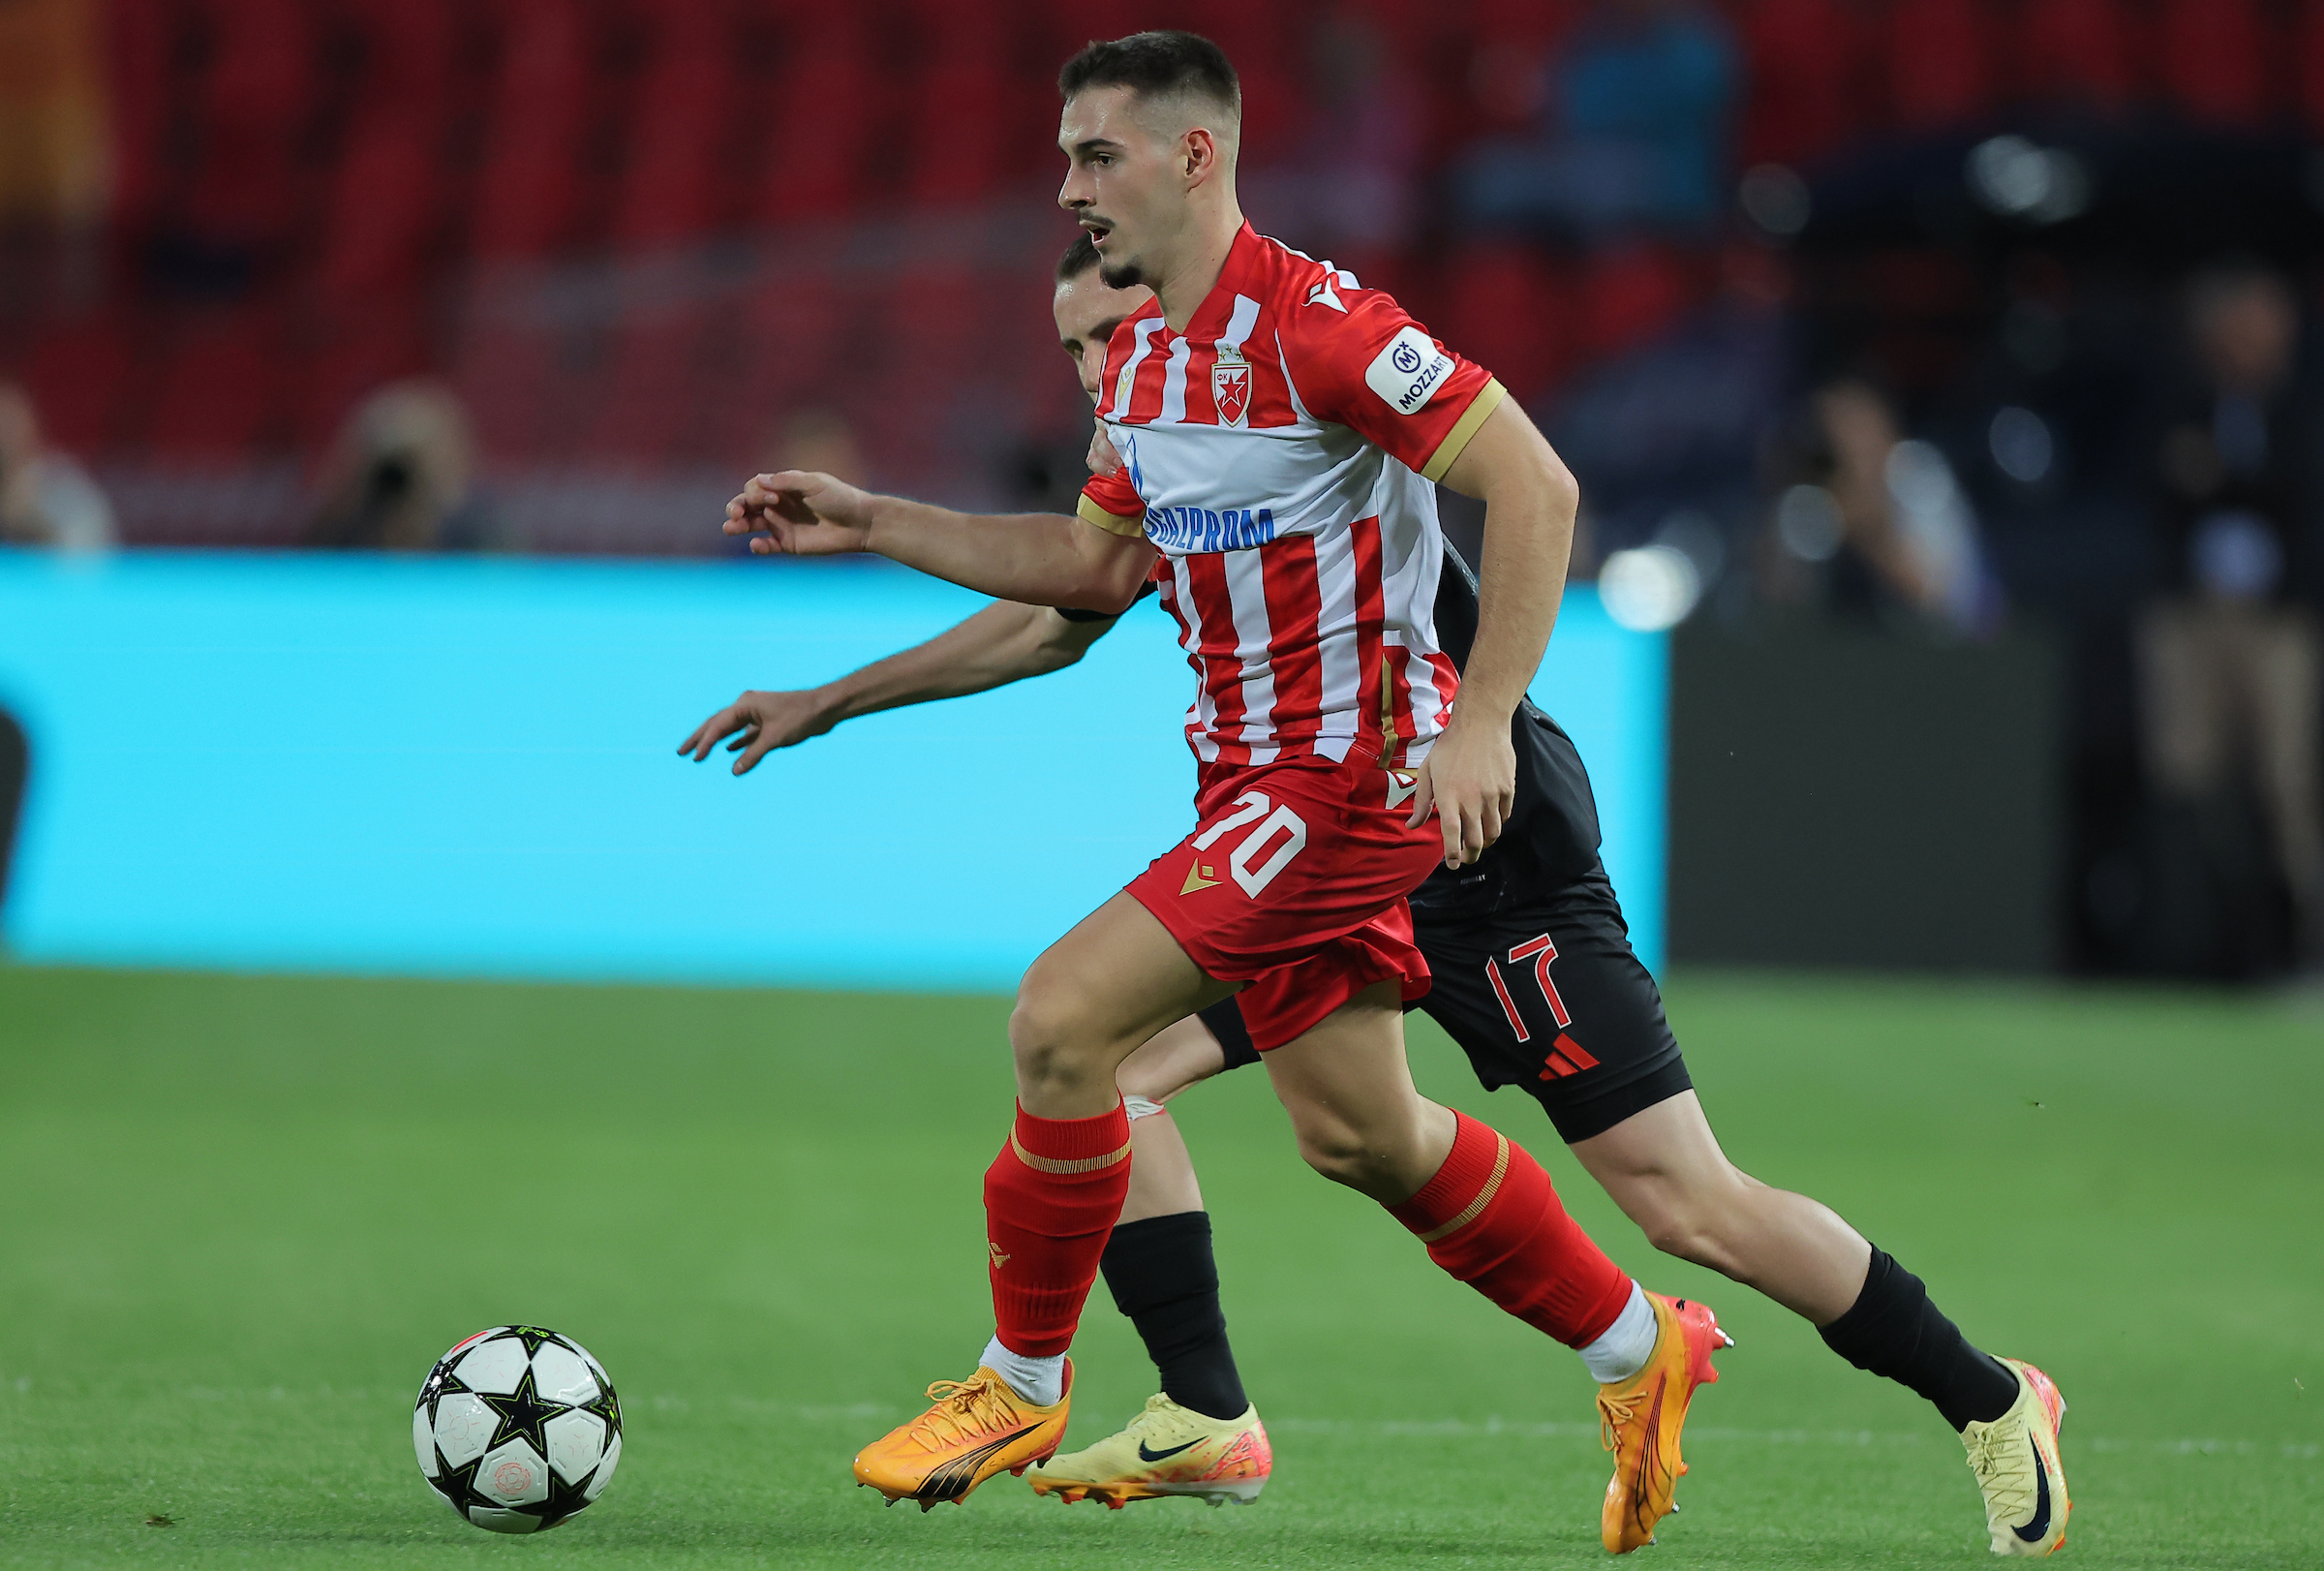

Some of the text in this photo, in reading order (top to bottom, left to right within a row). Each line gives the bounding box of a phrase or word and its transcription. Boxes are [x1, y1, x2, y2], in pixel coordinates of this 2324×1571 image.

[1398, 355, 1449, 410] MOZZART
[1191, 790, 1307, 900] 70
[1484, 932, 1573, 1043] 17
